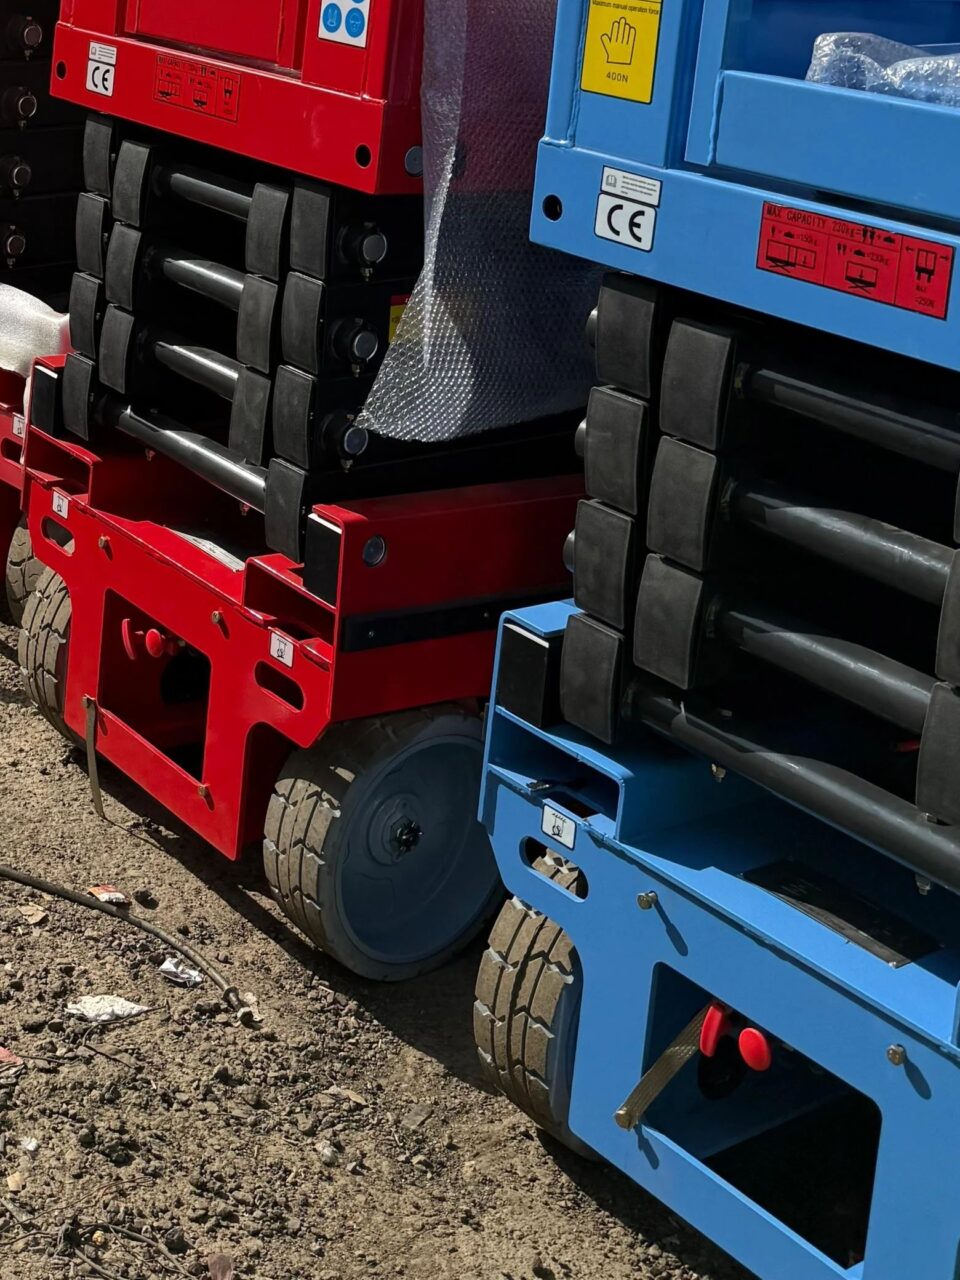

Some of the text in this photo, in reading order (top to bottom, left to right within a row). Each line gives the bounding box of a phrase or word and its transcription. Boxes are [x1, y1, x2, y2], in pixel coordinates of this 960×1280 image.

[92, 65, 110, 92] CE
[606, 71, 628, 83] 400N
[607, 204, 646, 243] CE
[767, 205, 781, 217] MAX
[787, 210, 826, 229] CAPACITY
